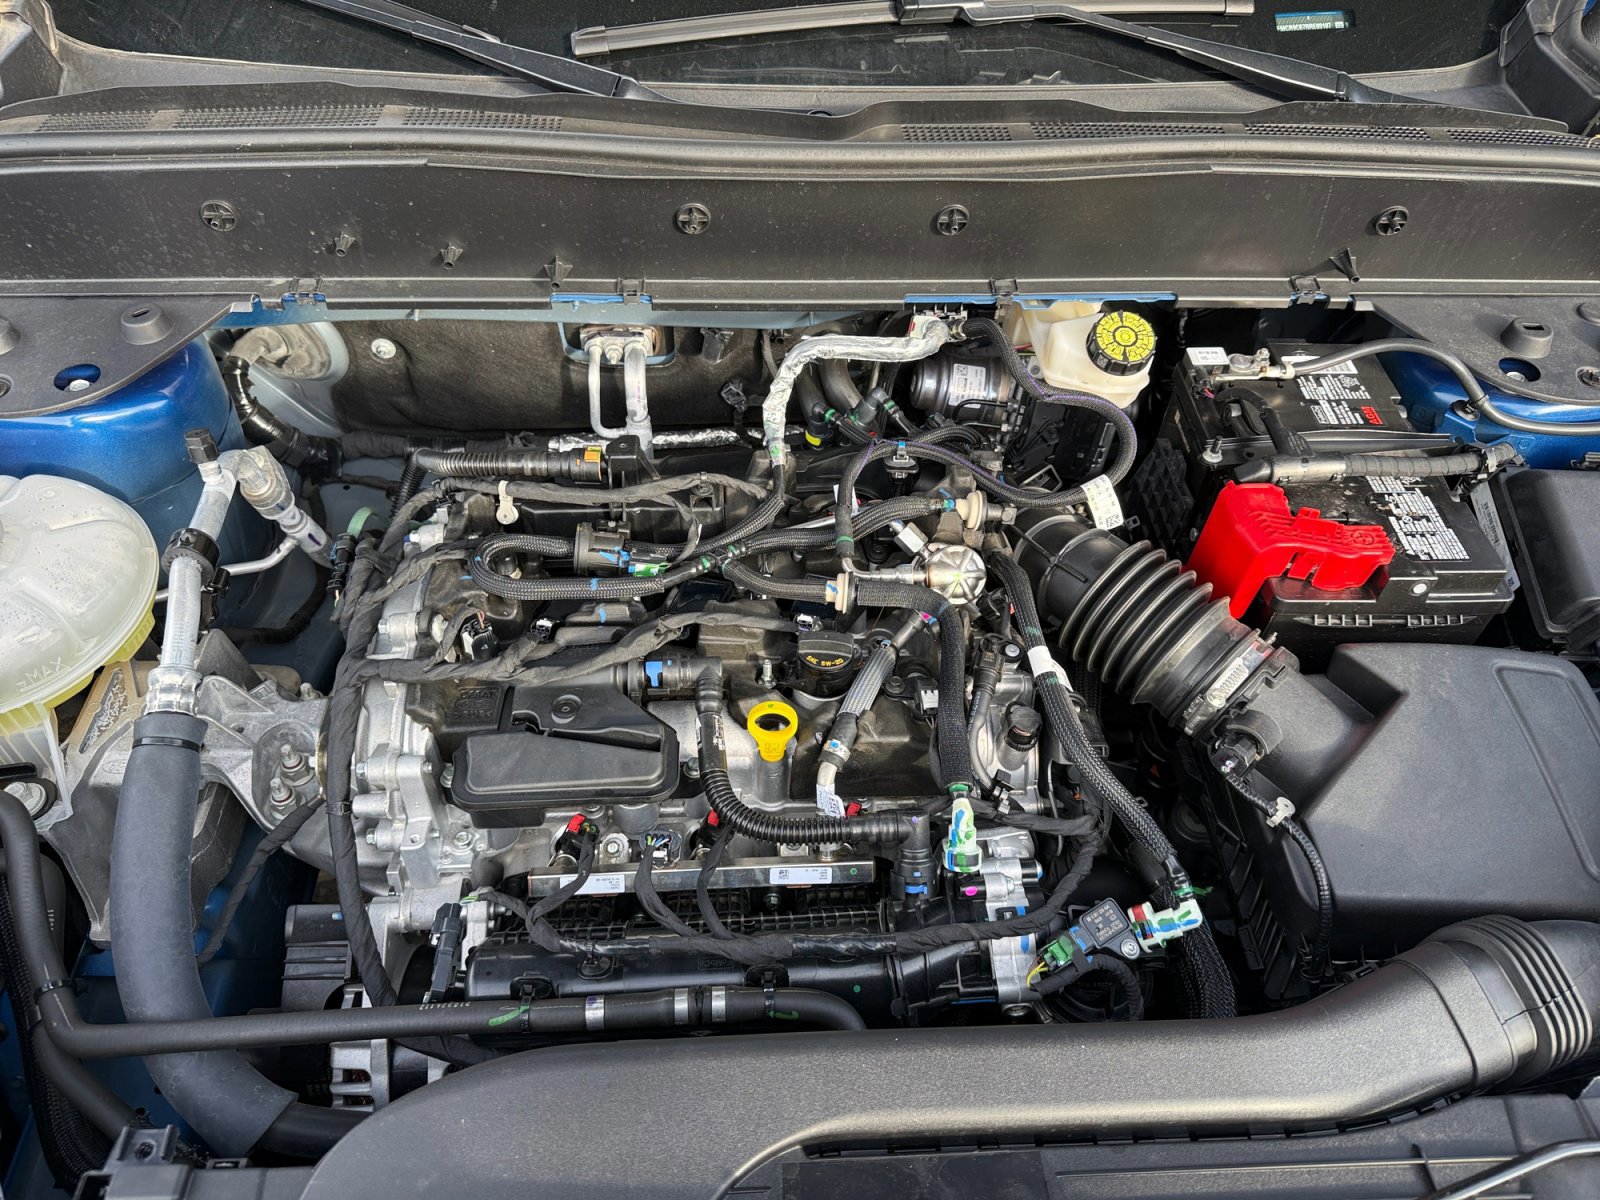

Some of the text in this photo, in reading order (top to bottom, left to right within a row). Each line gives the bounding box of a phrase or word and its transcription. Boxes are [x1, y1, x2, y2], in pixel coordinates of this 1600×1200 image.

[1361, 406, 1381, 424] AGM
[24, 655, 69, 685] MAX
[806, 655, 844, 667] SAE 5W-20
